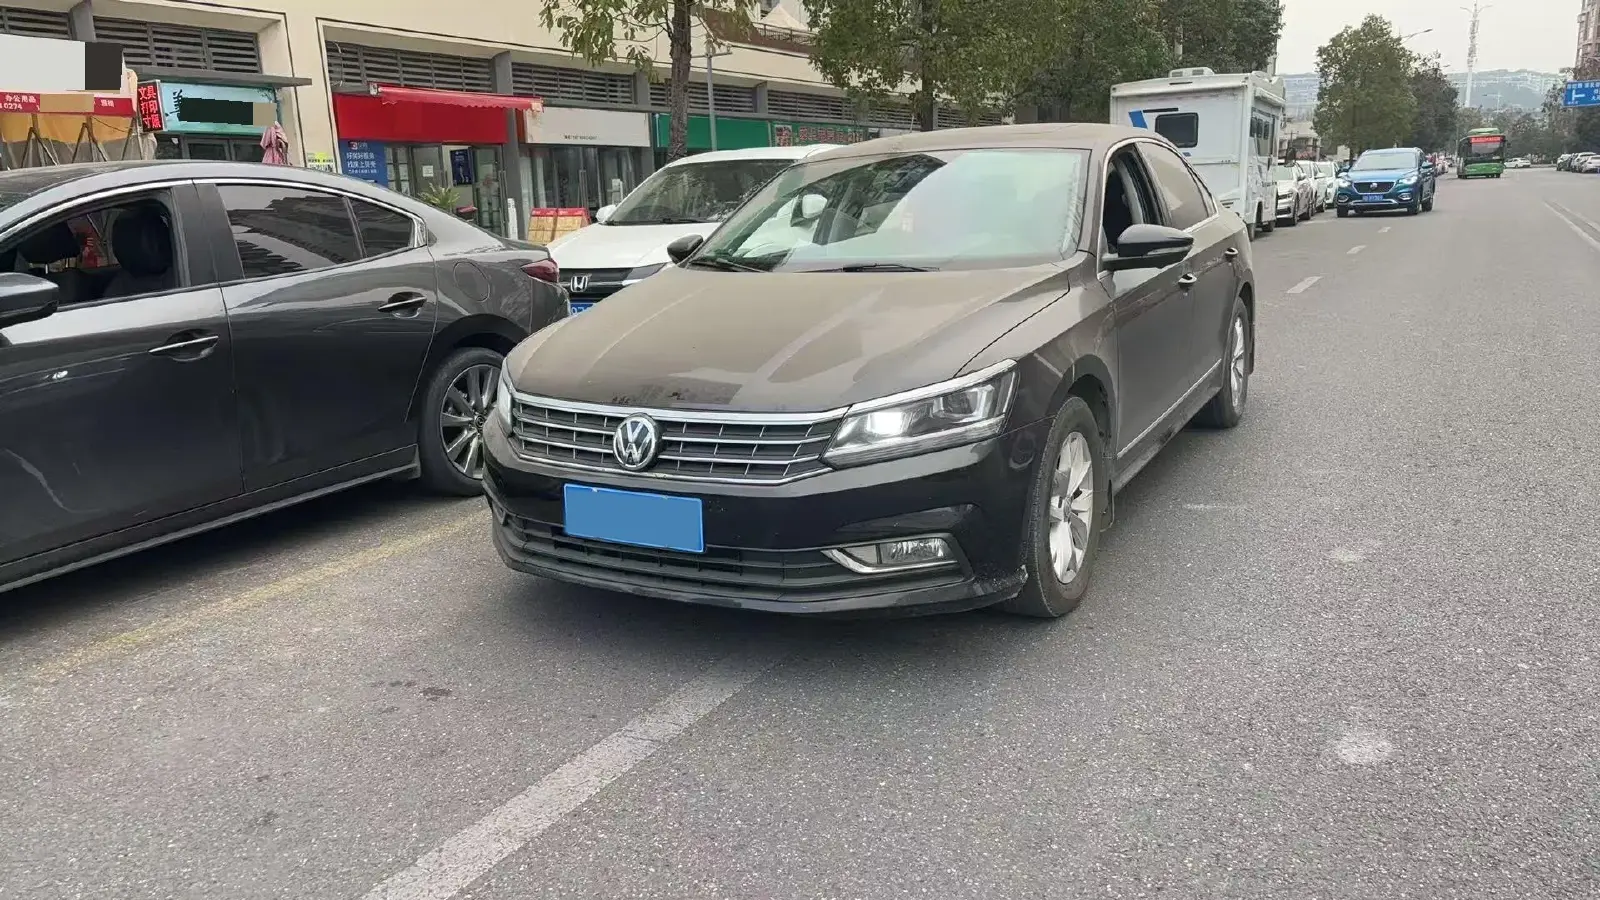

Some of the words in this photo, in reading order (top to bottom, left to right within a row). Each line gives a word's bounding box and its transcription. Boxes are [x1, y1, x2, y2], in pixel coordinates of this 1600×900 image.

[5, 94, 37, 104] 办公用品
[138, 85, 157, 100] 文具
[140, 100, 159, 114] 打印
